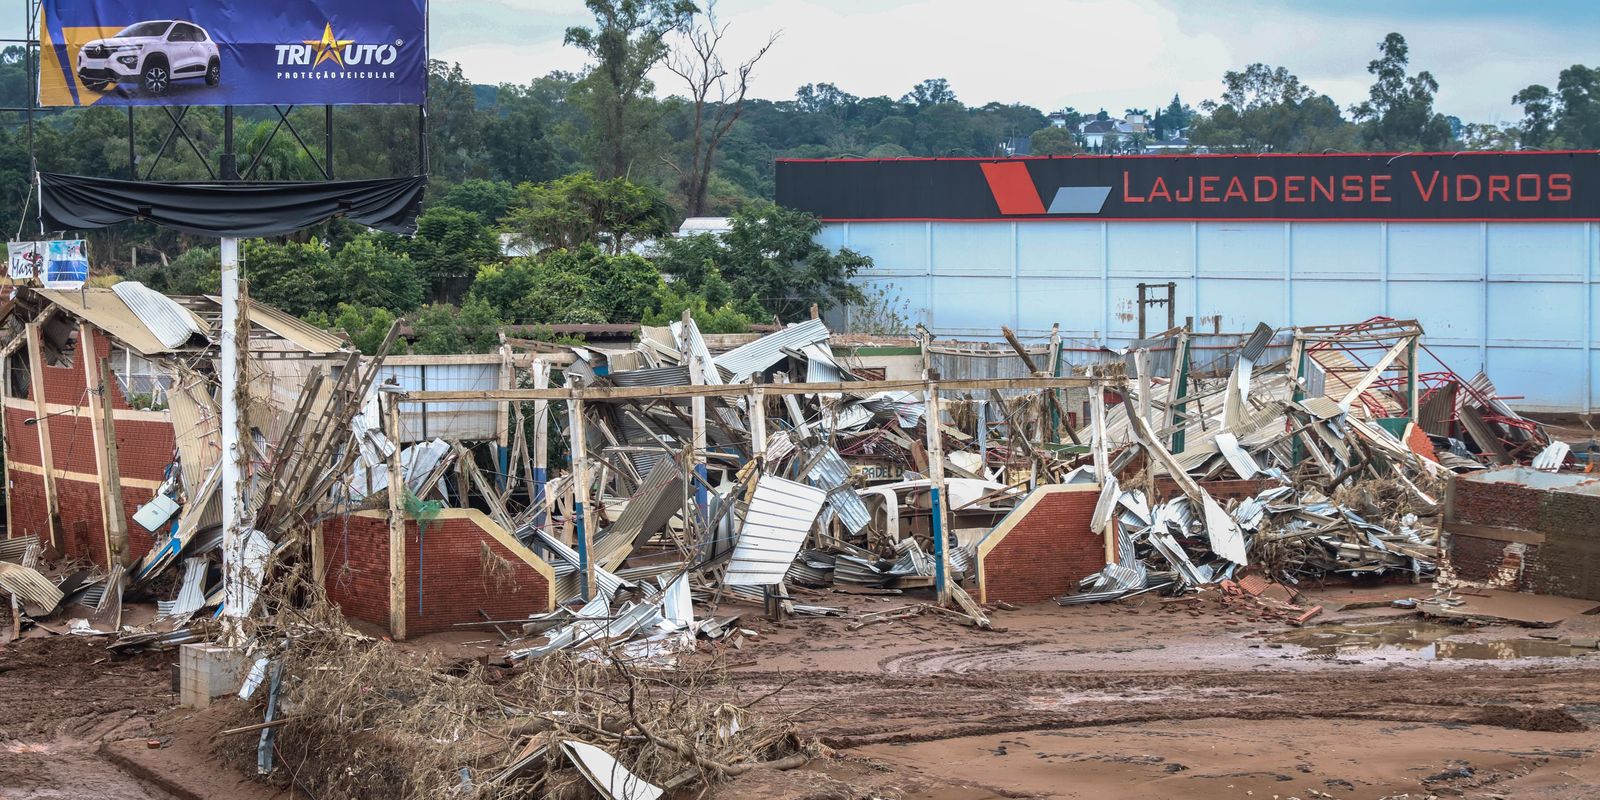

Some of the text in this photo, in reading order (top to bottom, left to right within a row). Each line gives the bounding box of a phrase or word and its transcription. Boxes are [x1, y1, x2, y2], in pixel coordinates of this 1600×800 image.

[277, 71, 336, 79] PROTEÇÃO
[1123, 170, 1573, 202] LAJEADENSE VIDROS
